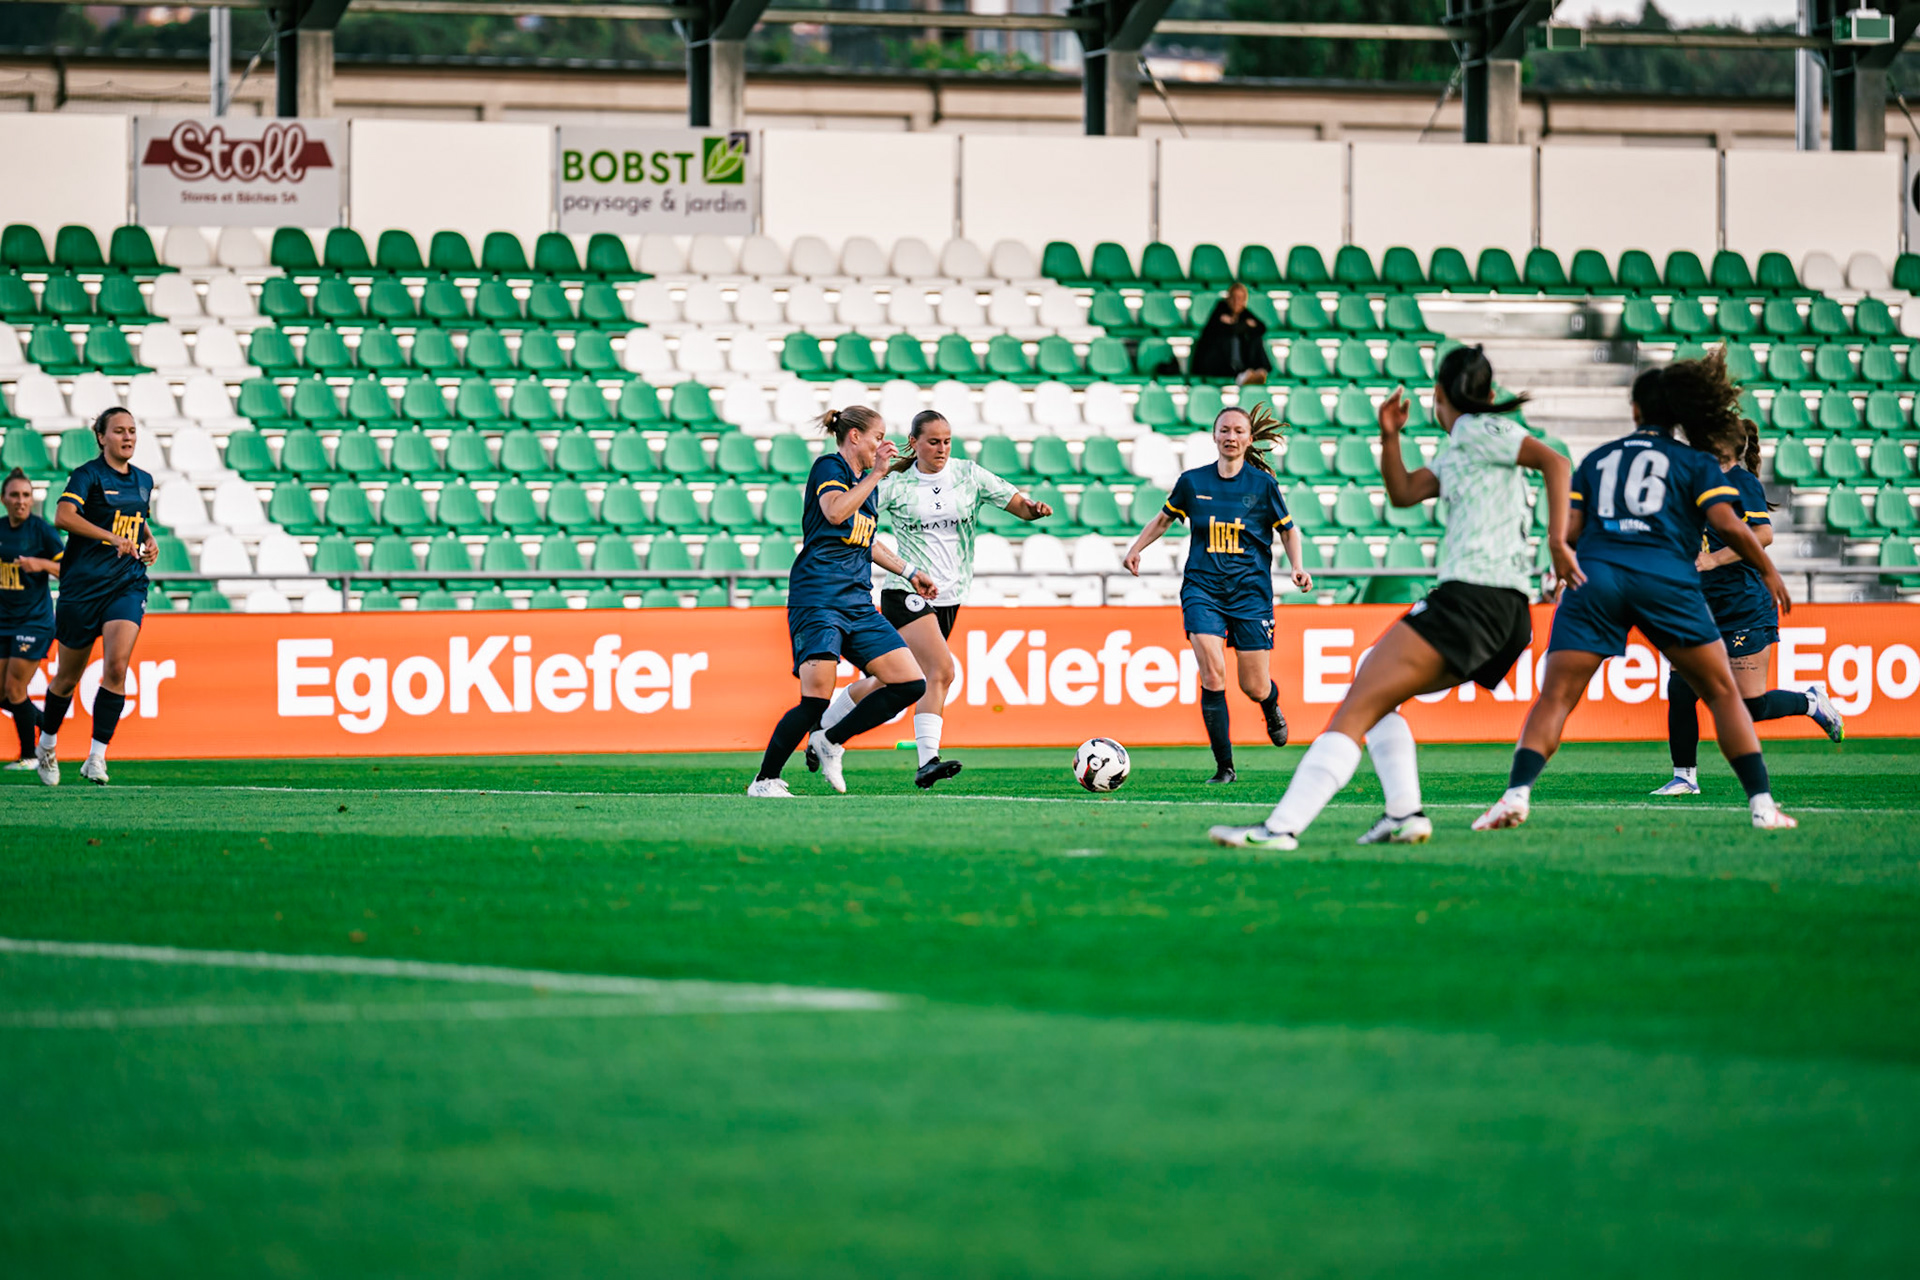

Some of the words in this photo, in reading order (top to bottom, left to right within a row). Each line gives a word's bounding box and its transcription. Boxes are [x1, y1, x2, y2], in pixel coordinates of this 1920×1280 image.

[170, 121, 306, 182] Stoll
[563, 150, 694, 184] BOBST
[221, 191, 233, 203] et
[563, 195, 651, 216] paysage
[660, 189, 675, 212] &
[684, 191, 746, 216] jardin
[1596, 449, 1670, 518] 16
[277, 634, 708, 734] EgoKiefer
